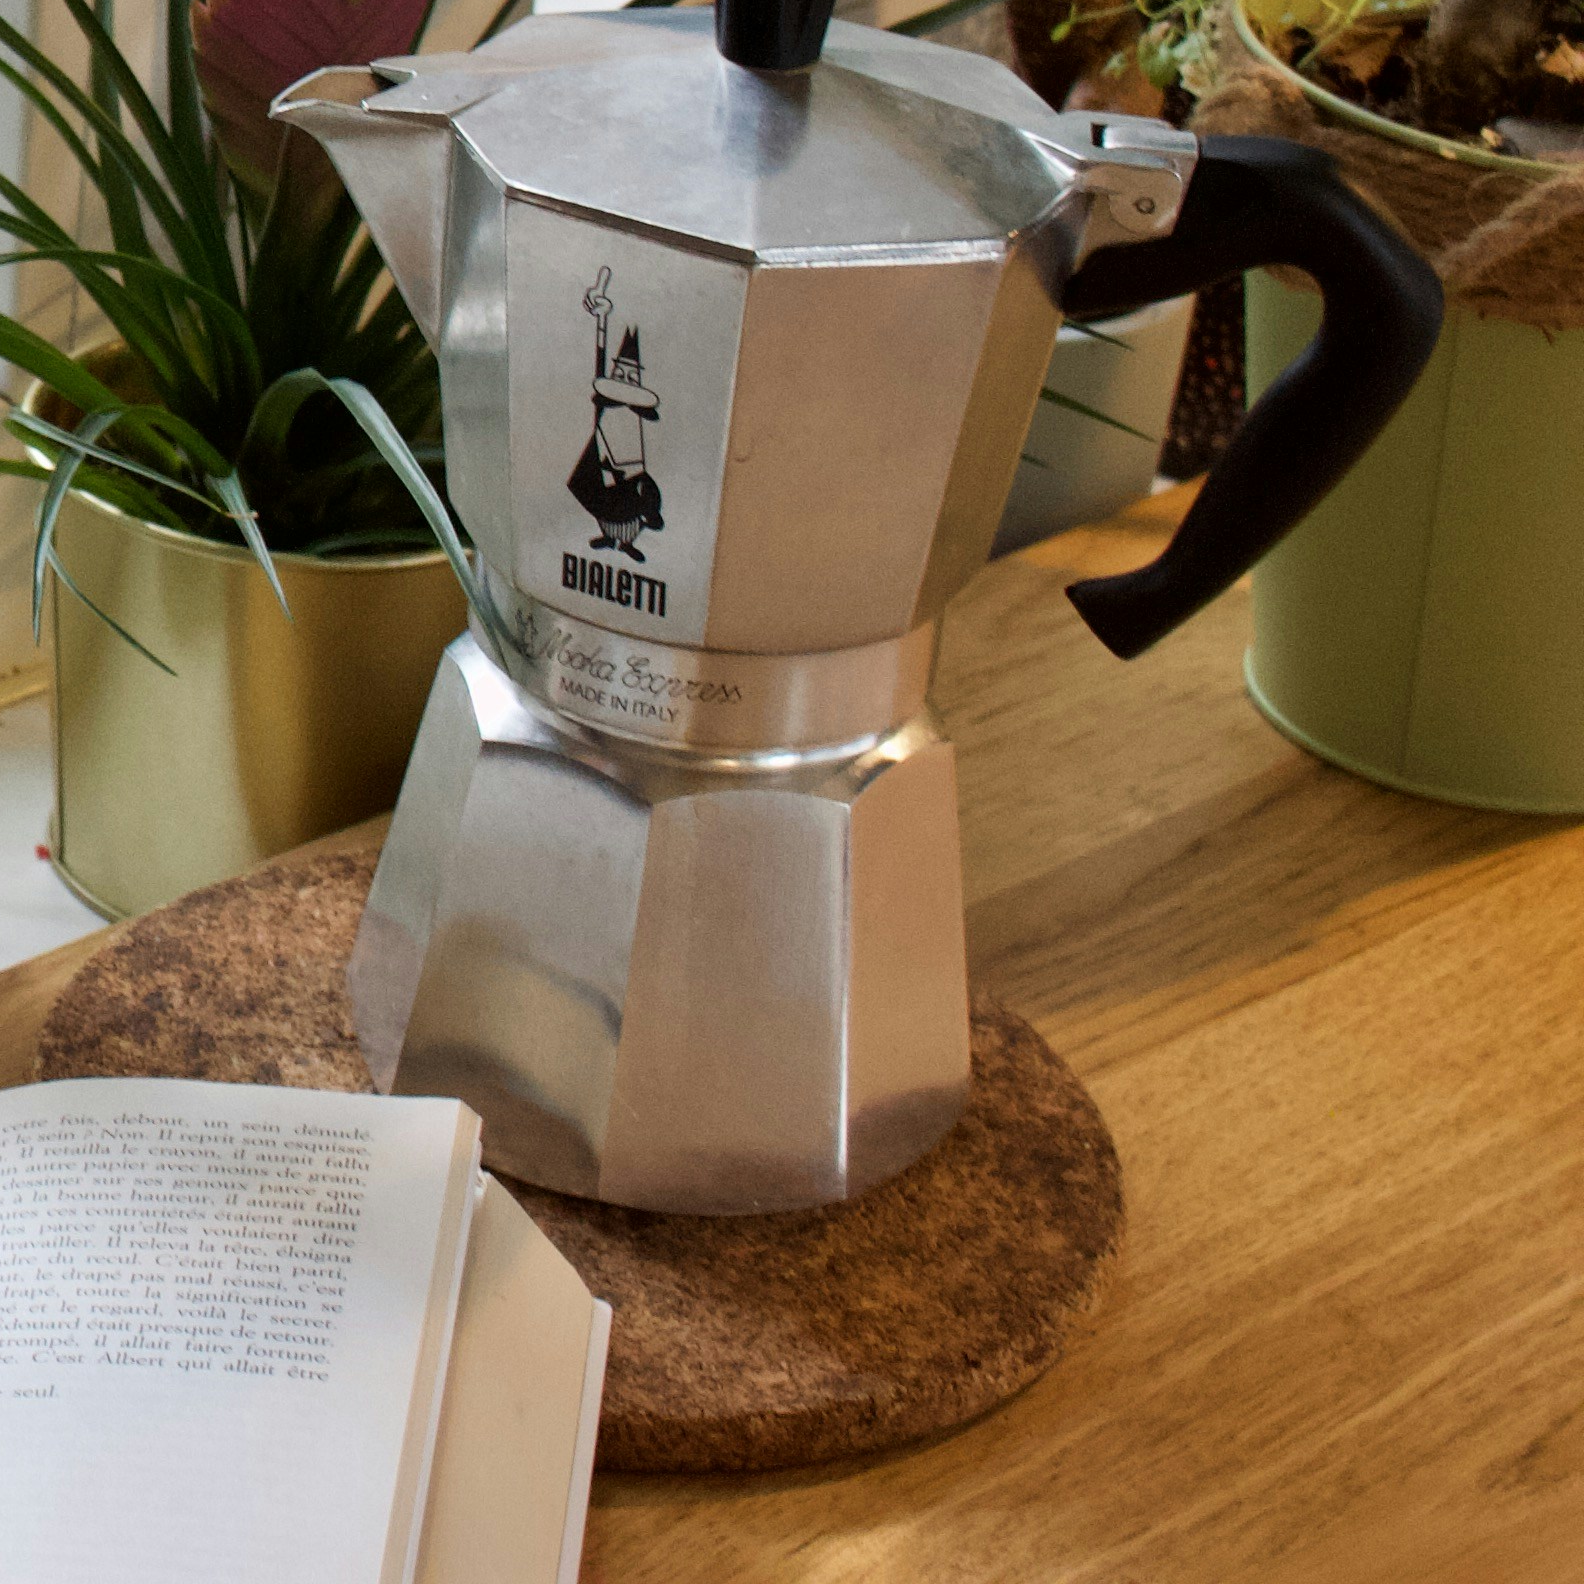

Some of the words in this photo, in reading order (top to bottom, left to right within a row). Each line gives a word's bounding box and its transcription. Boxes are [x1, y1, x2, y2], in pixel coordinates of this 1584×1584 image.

[562, 551, 666, 618] BIALETTI
[541, 627, 618, 682] Moka
[622, 655, 743, 705] Express
[559, 676, 606, 706] MADE
[610, 694, 629, 713] IN
[632, 701, 680, 723] ITALY
[236, 1258, 280, 1272] bien
[62, 1268, 122, 1284] drapé
[131, 1273, 164, 1284] pas
[174, 1273, 212, 1285] mal
[298, 1280, 344, 1297] c'est
[60, 1300, 78, 1312] le
[178, 1306, 226, 1320] voilà
[240, 1308, 258, 1321] le
[76, 1287, 130, 1298] toute
[144, 1286, 162, 1298] la
[176, 1290, 306, 1312] signification
[322, 1303, 343, 1313] se
[86, 1320, 131, 1331] était
[139, 1324, 224, 1338] presque
[230, 1325, 256, 1339] de
[94, 1335, 106, 1347] il
[120, 1336, 171, 1350] allait
[185, 1339, 232, 1354] faire
[32, 1352, 85, 1364] C'est
[97, 1352, 165, 1367] Albert
[177, 1358, 212, 1372] qui
[223, 1359, 276, 1376] allait
[287, 1367, 330, 1382] être
